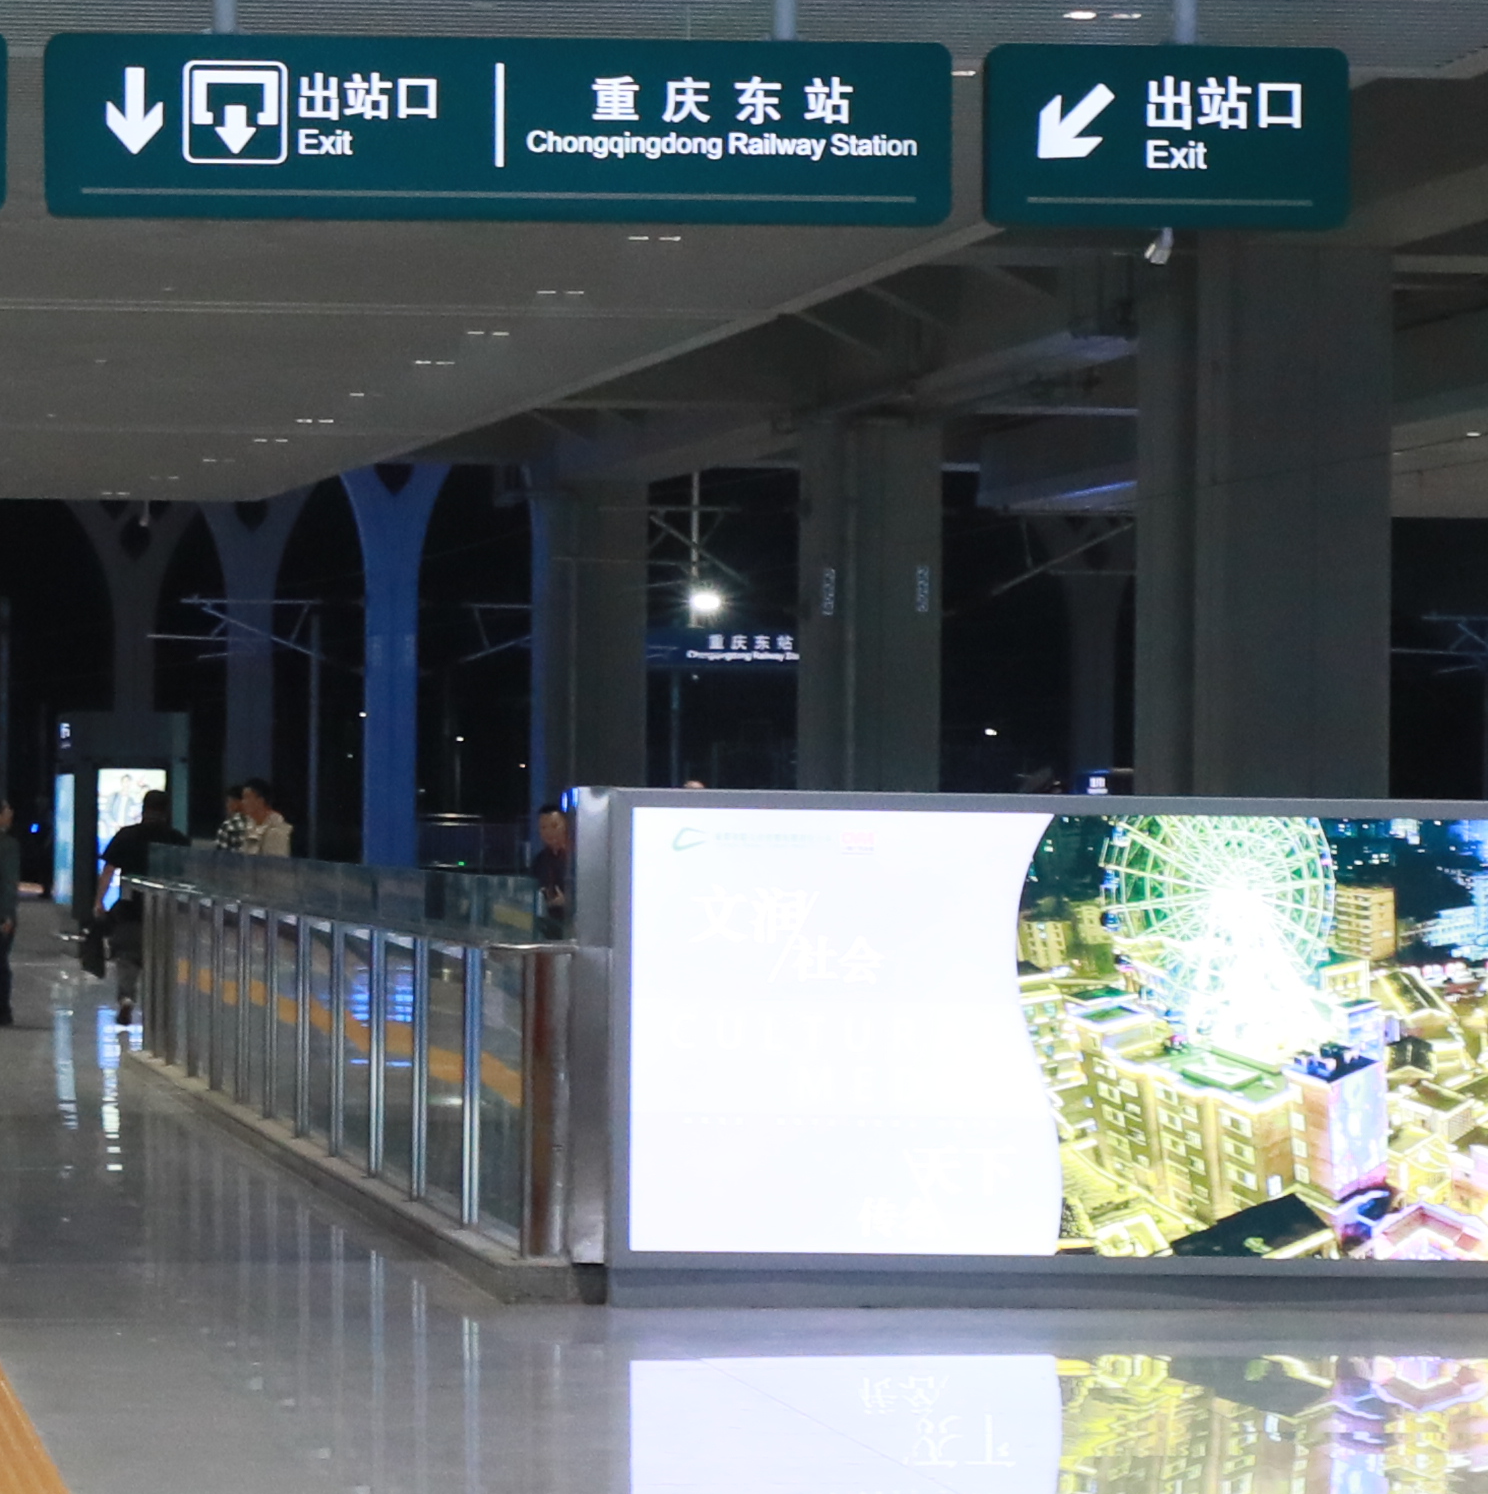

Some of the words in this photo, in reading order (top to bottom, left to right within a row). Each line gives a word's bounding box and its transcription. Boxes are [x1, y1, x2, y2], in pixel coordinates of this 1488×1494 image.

[298, 72, 438, 121] 出站口
[591, 75, 854, 125] 重庆东站
[1146, 75, 1303, 131] 出站口
[298, 128, 354, 156] Exit
[526, 130, 723, 160] Chongqingdong
[728, 132, 827, 162] Railway
[830, 133, 918, 157] Station
[1146, 139, 1208, 170] Exit
[708, 634, 794, 650] 重庆东站
